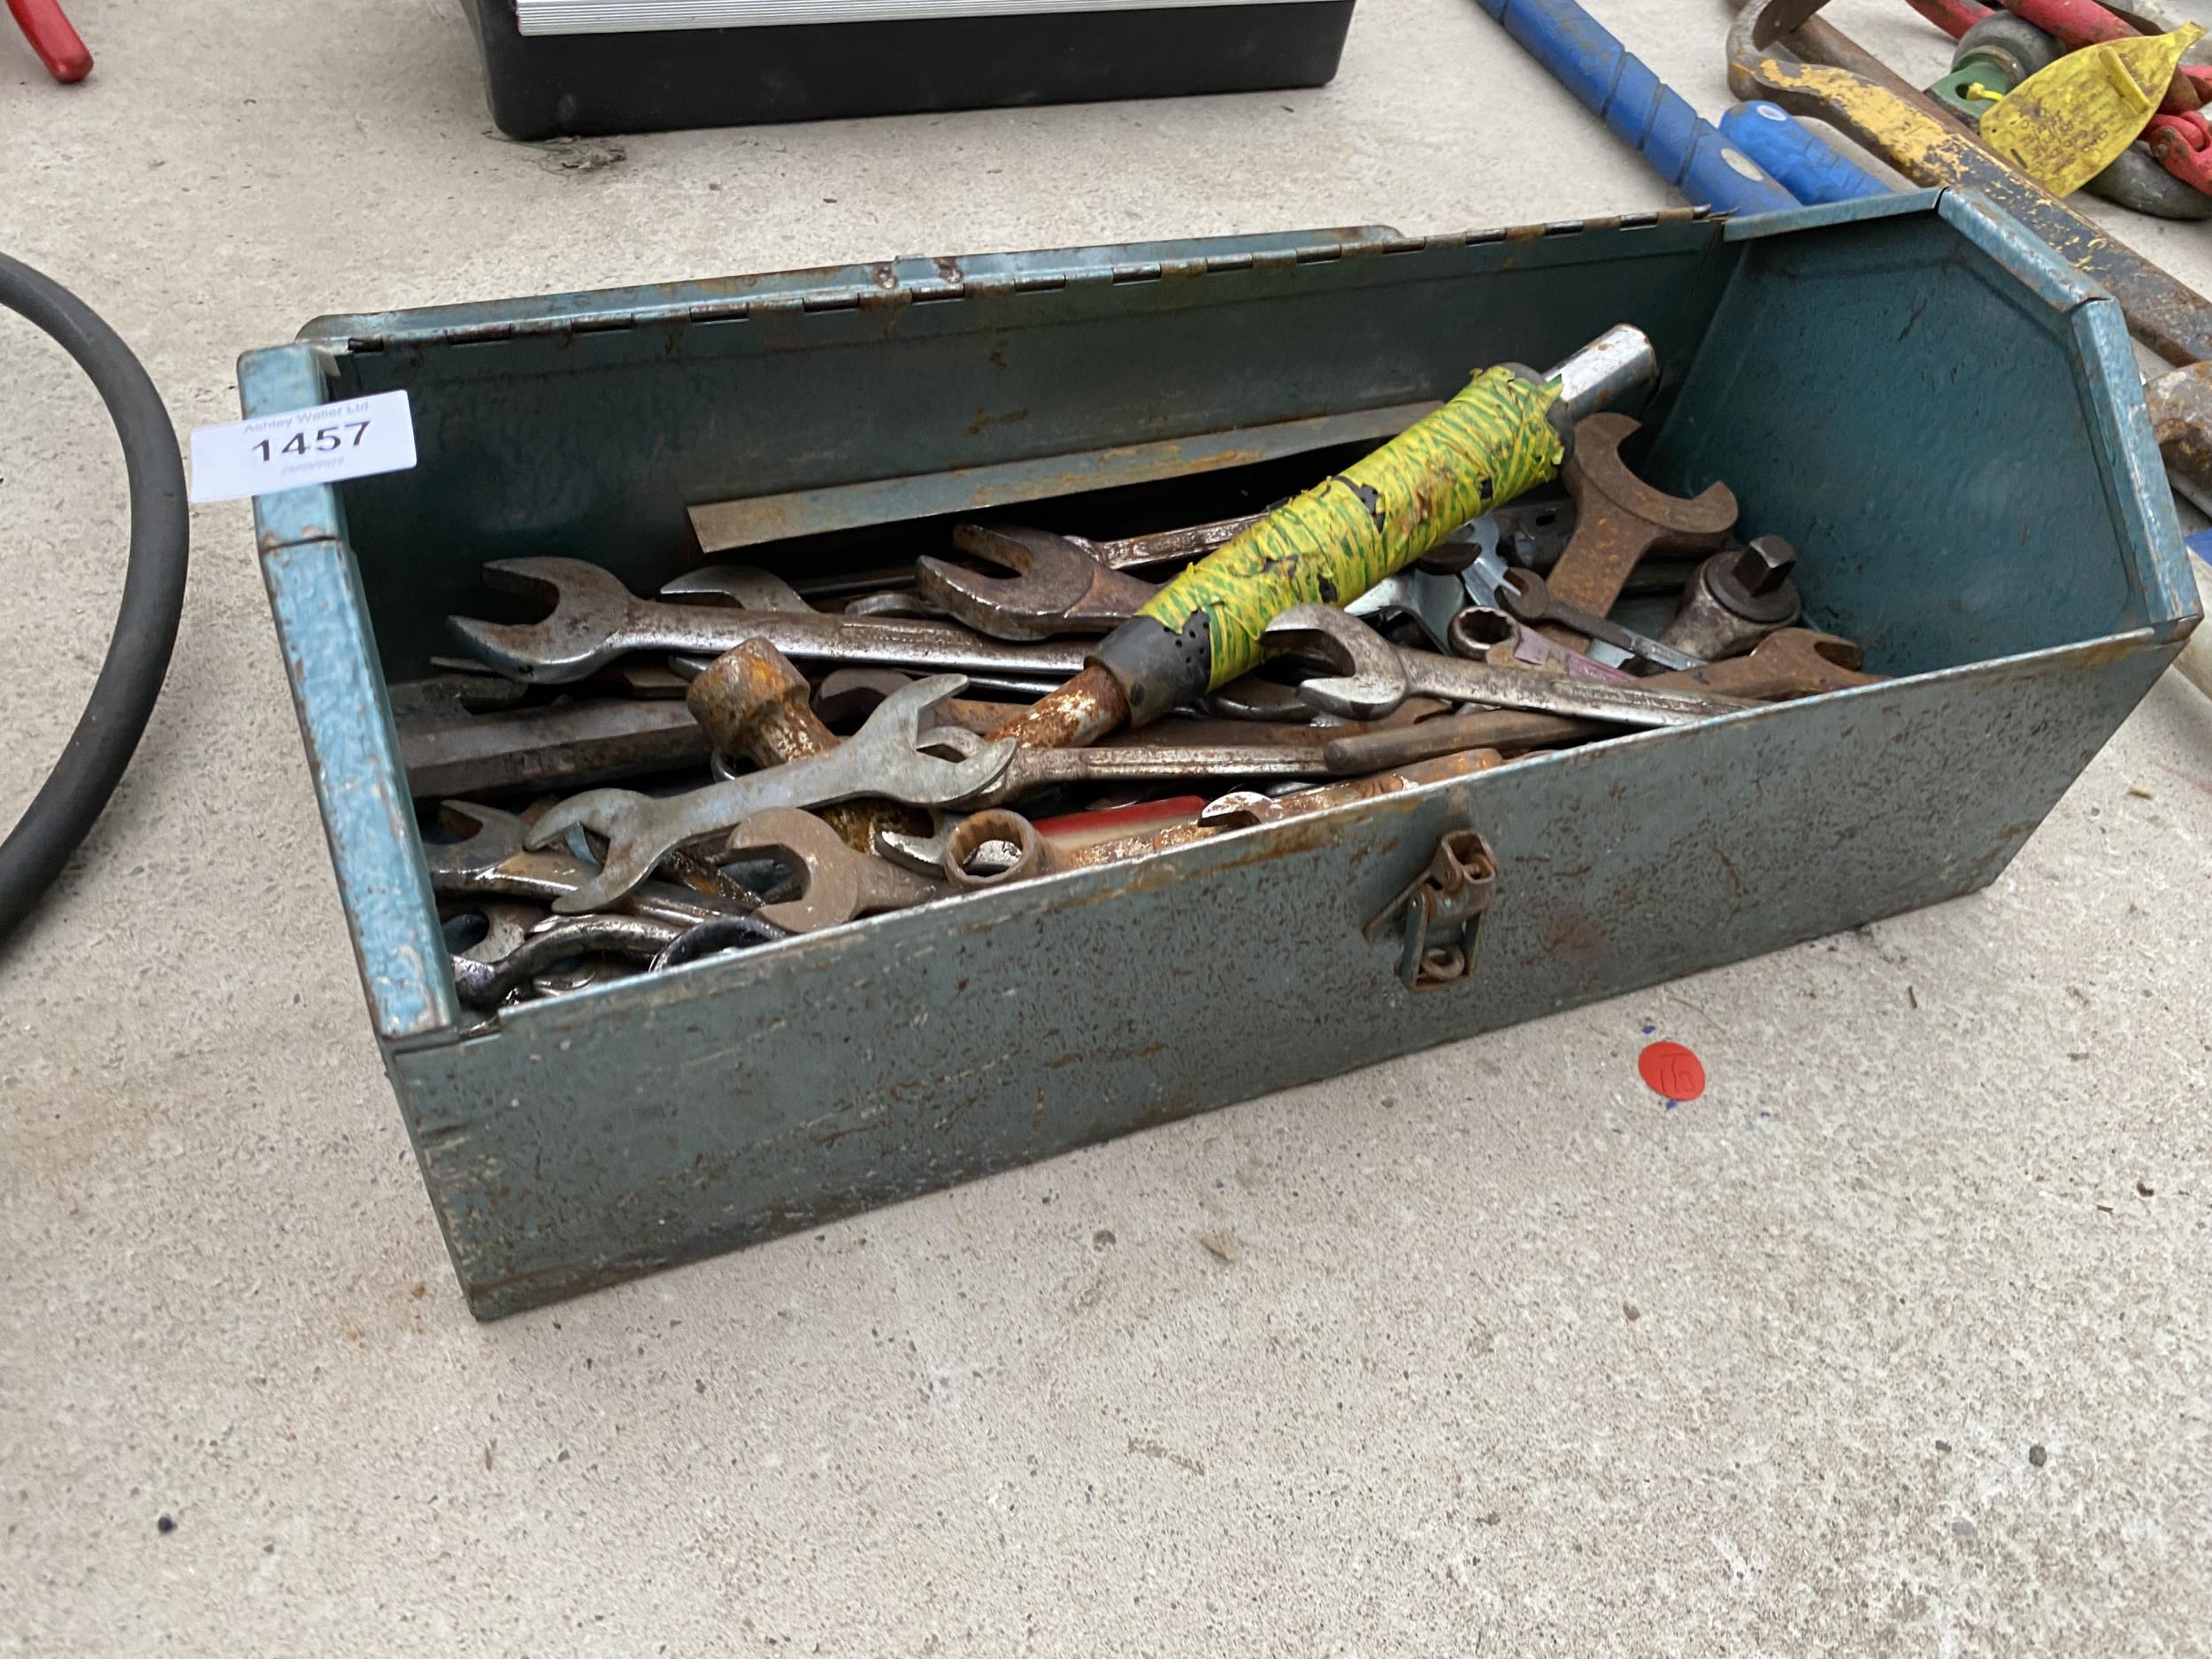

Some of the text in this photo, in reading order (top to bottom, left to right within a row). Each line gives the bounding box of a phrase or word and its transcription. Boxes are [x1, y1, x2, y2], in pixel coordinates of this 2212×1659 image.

[244, 419, 293, 434] Ashley
[348, 402, 369, 414] Ltd
[253, 421, 370, 461] 1457
